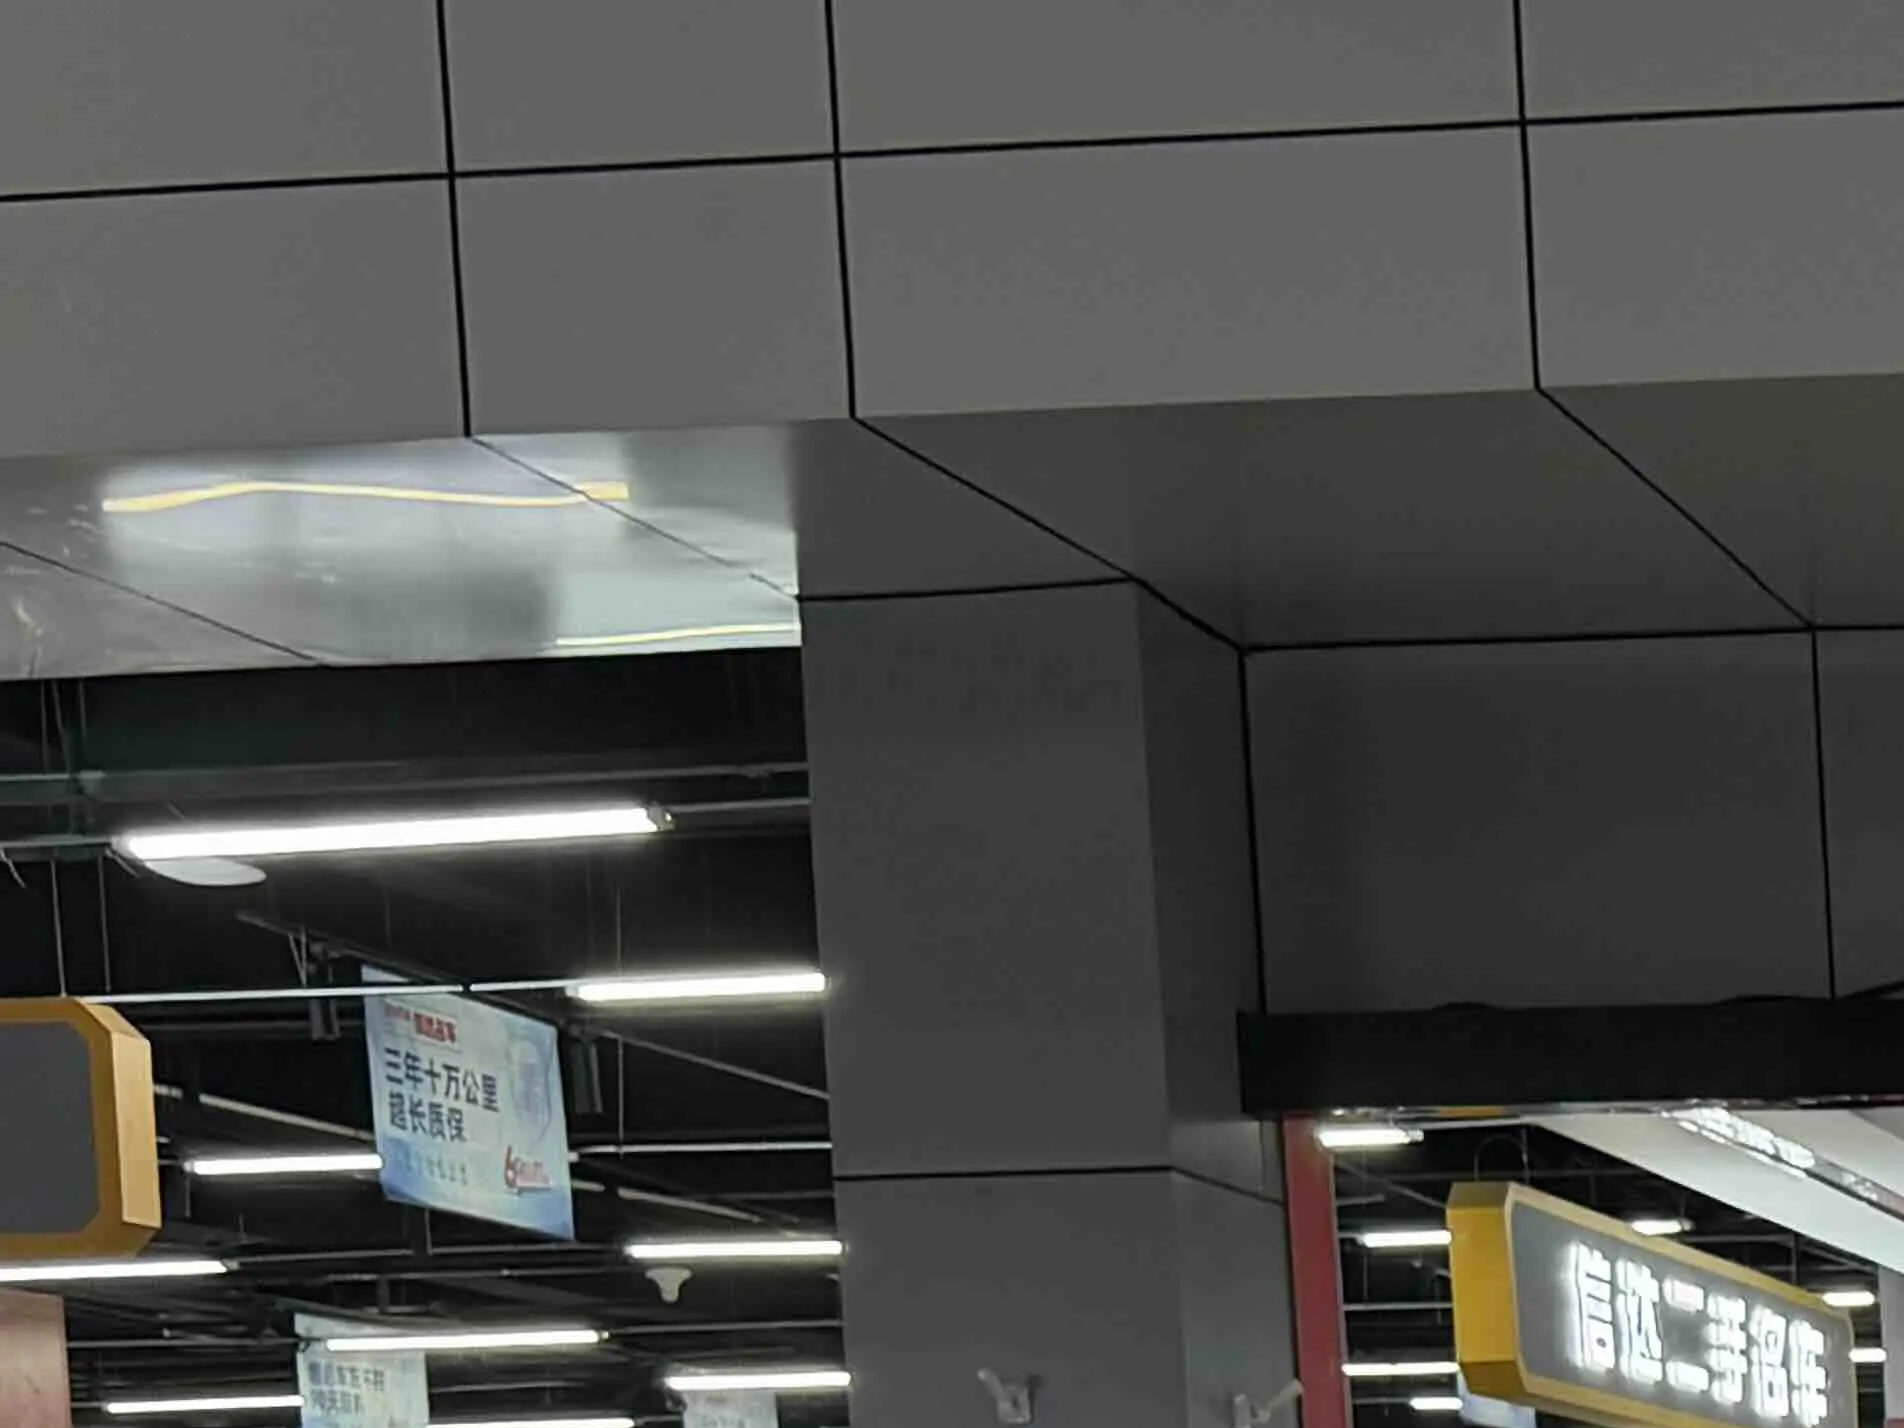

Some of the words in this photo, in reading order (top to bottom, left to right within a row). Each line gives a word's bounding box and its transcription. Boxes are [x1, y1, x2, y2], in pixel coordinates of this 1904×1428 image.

[385, 1048, 499, 1112] 三年十万公里
[388, 1091, 467, 1142] 超长质保
[1567, 1240, 1828, 1428] 信达二手名车
